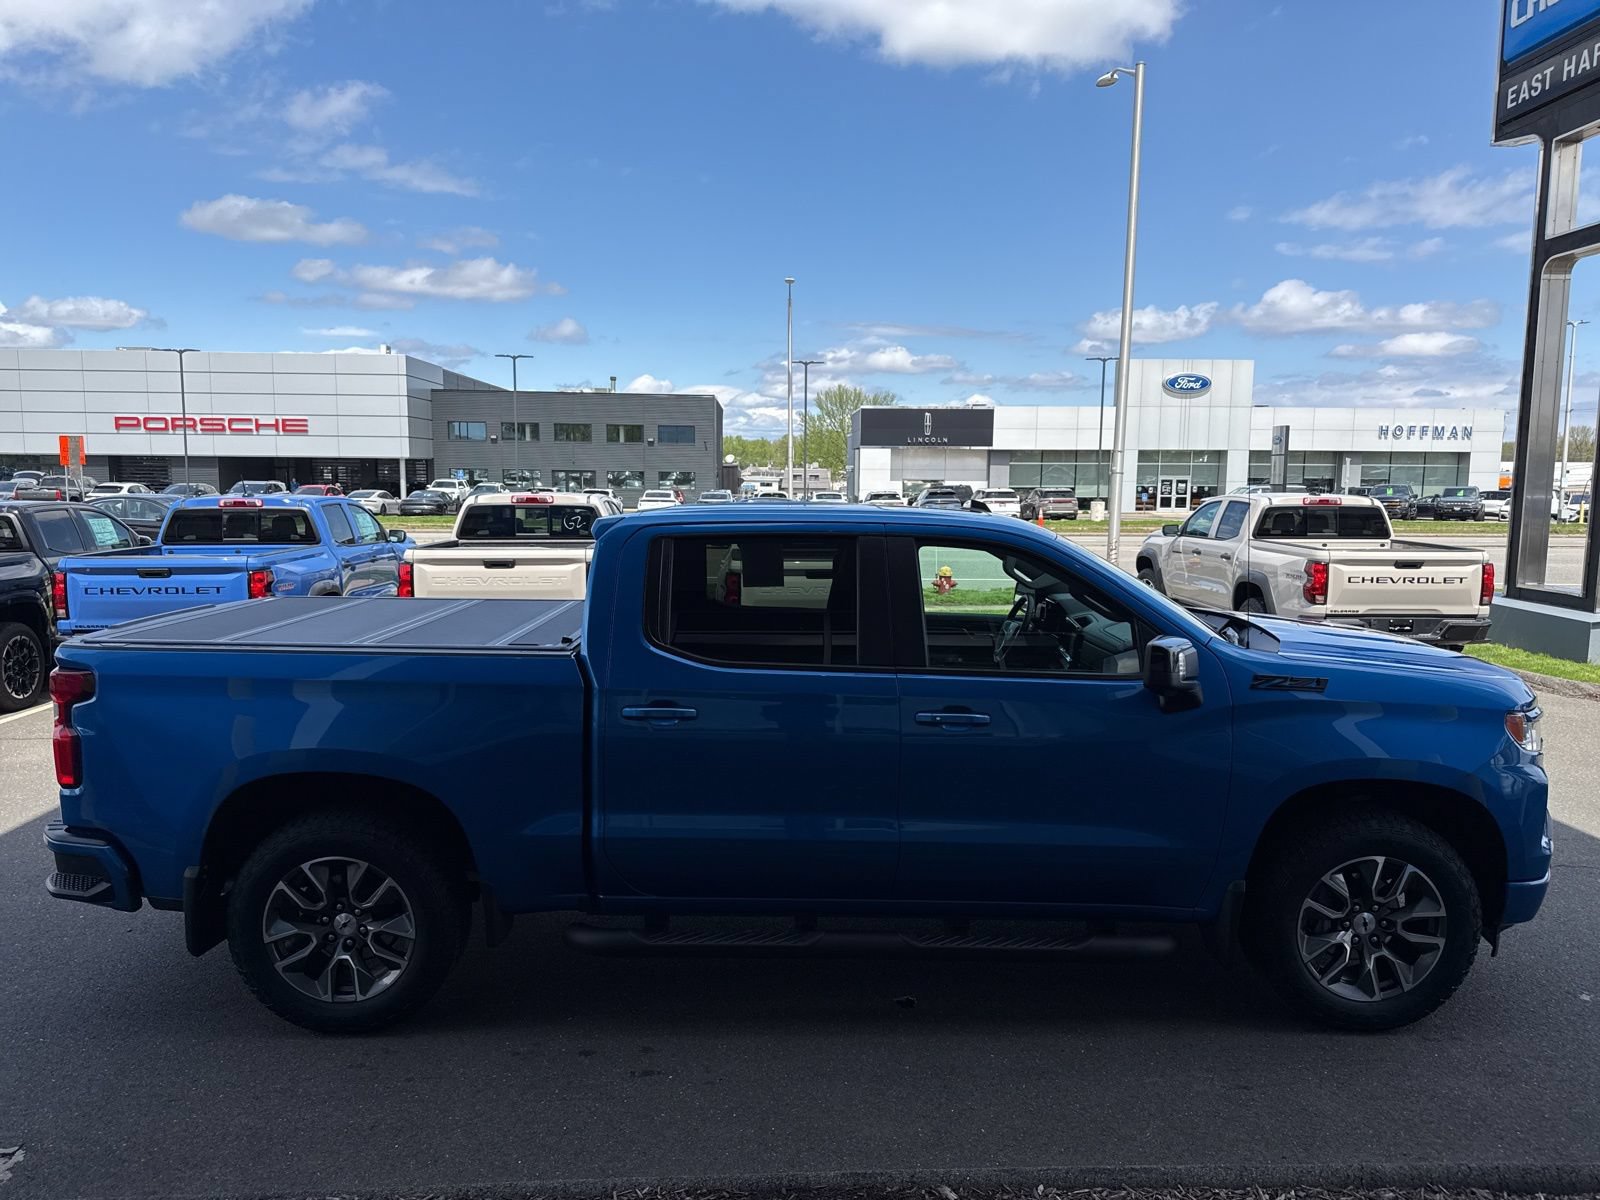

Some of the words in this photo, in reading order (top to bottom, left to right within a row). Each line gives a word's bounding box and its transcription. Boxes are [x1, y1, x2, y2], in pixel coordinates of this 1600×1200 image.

[1507, 66, 1555, 109] EAST
[1175, 376, 1202, 389] Ford
[114, 416, 309, 434] PORSCHE
[1378, 424, 1473, 440] HOFFMAN
[431, 575, 568, 587] CHEVROLET
[1347, 576, 1468, 584] CHEVROLET
[84, 586, 226, 596] CHEVROLET
